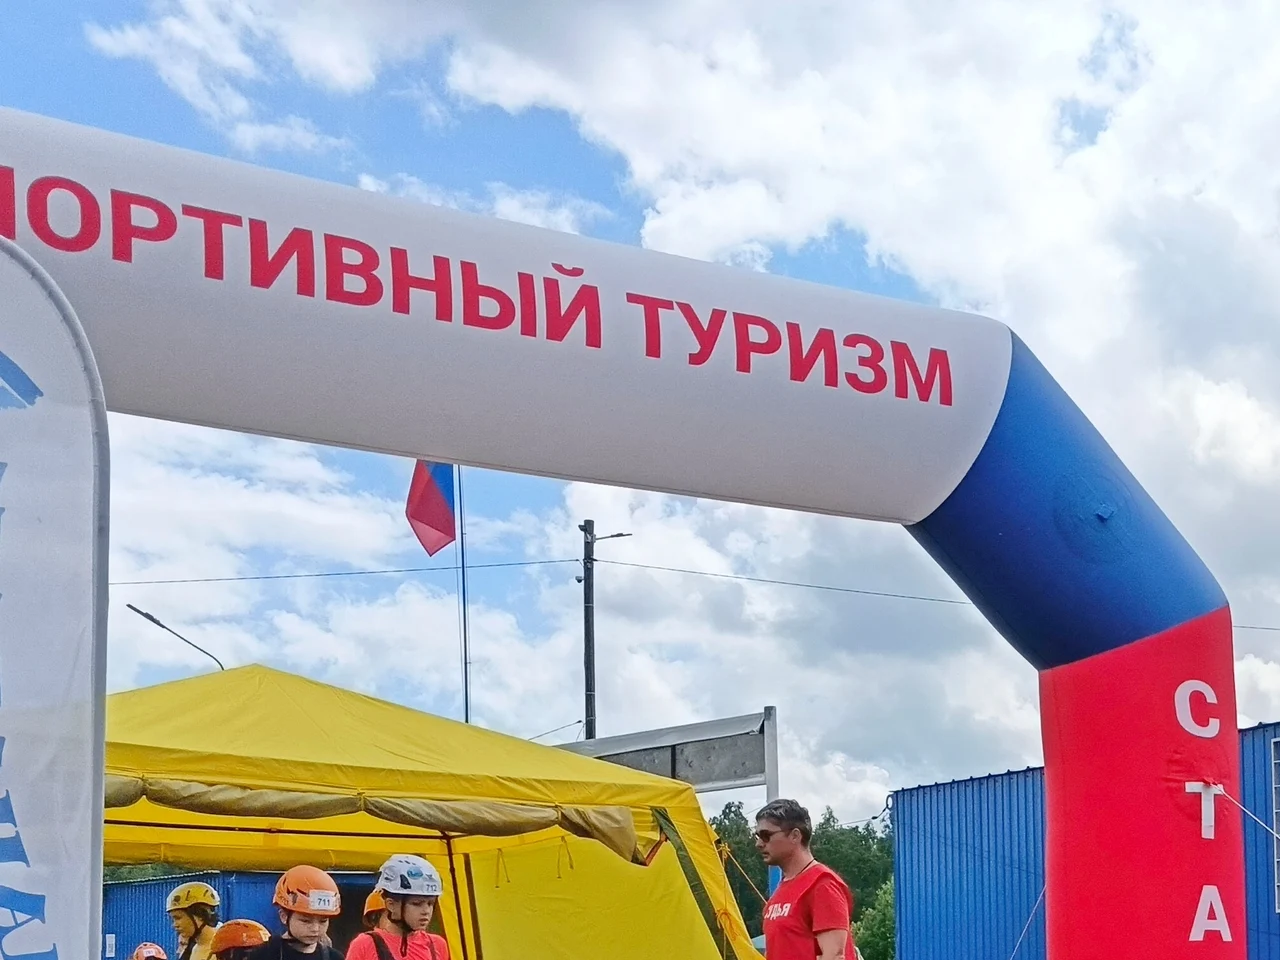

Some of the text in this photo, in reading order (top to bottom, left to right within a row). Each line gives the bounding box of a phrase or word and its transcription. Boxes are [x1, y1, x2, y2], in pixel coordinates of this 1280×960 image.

[0, 165, 954, 407] ОРТИВНЫЙ ТУРИЗМ
[317, 897, 331, 907] 711
[764, 902, 792, 921] УДЬЯ
